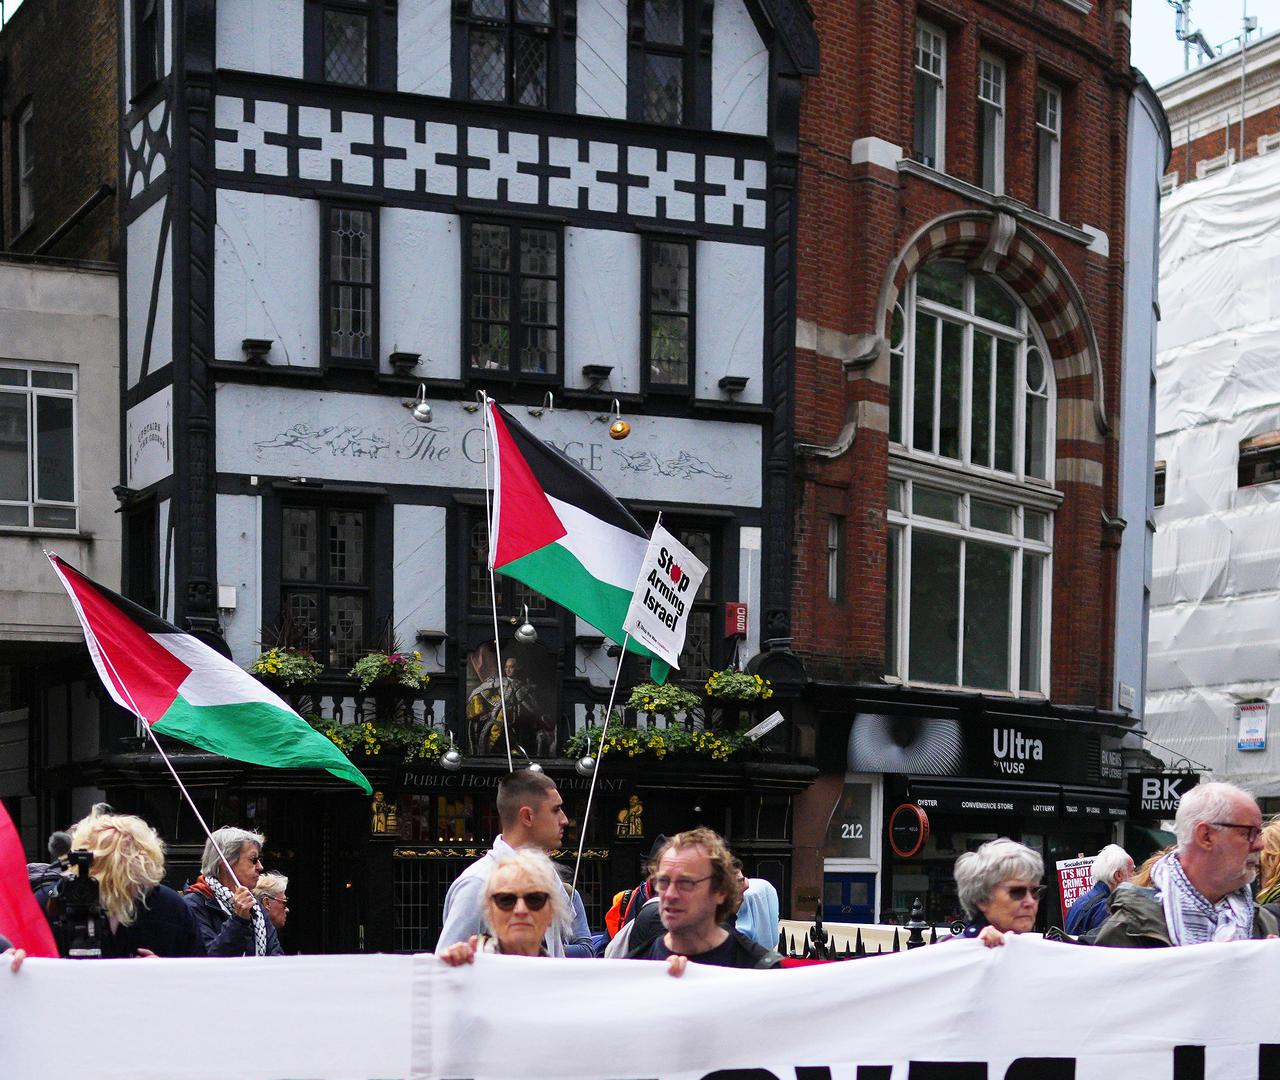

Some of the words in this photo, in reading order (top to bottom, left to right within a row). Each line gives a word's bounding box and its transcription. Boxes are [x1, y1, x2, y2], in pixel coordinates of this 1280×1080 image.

[397, 423, 450, 462] The
[657, 546, 690, 593] Stop
[647, 568, 685, 617] Arming
[643, 587, 679, 633] Israel
[993, 728, 1043, 761] Ultra
[403, 772, 457, 787] PUBLIC
[461, 774, 504, 788] HOUS
[1142, 778, 1182, 800] BK
[917, 799, 938, 807] OYSTER
[1032, 804, 1055, 812] LOTTERY
[1141, 800, 1180, 811] NEWS
[841, 823, 863, 839] 212
[1061, 869, 1074, 879] IT'S
[1076, 867, 1090, 878] NOT
[1062, 878, 1083, 888] CRIME
[1064, 888, 1076, 898] ACT
